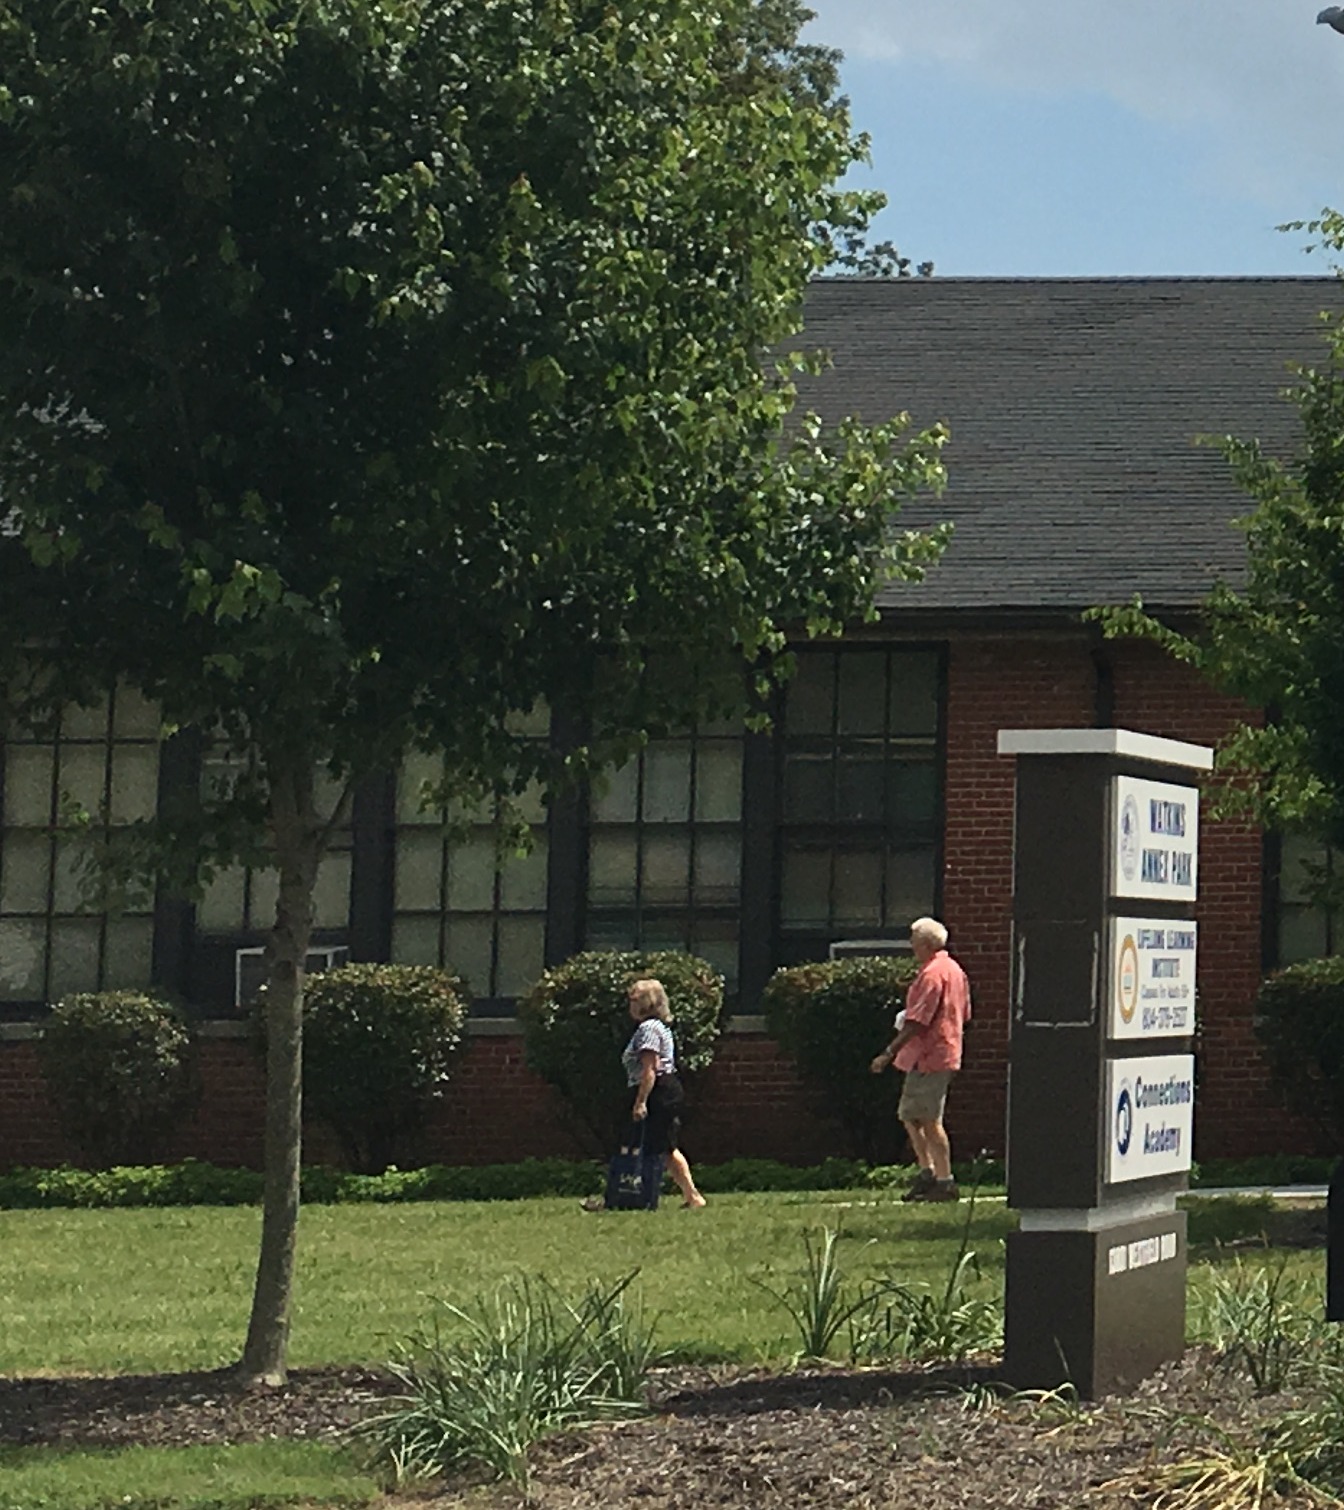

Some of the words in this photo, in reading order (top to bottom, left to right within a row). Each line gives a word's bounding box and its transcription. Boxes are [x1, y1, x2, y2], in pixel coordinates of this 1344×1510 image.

[1150, 799, 1186, 837] WATKINS
[1141, 849, 1169, 884] ANNEX
[1172, 851, 1192, 886] PARK
[1135, 1075, 1191, 1109] Connections
[1144, 1121, 1181, 1156] Academy
